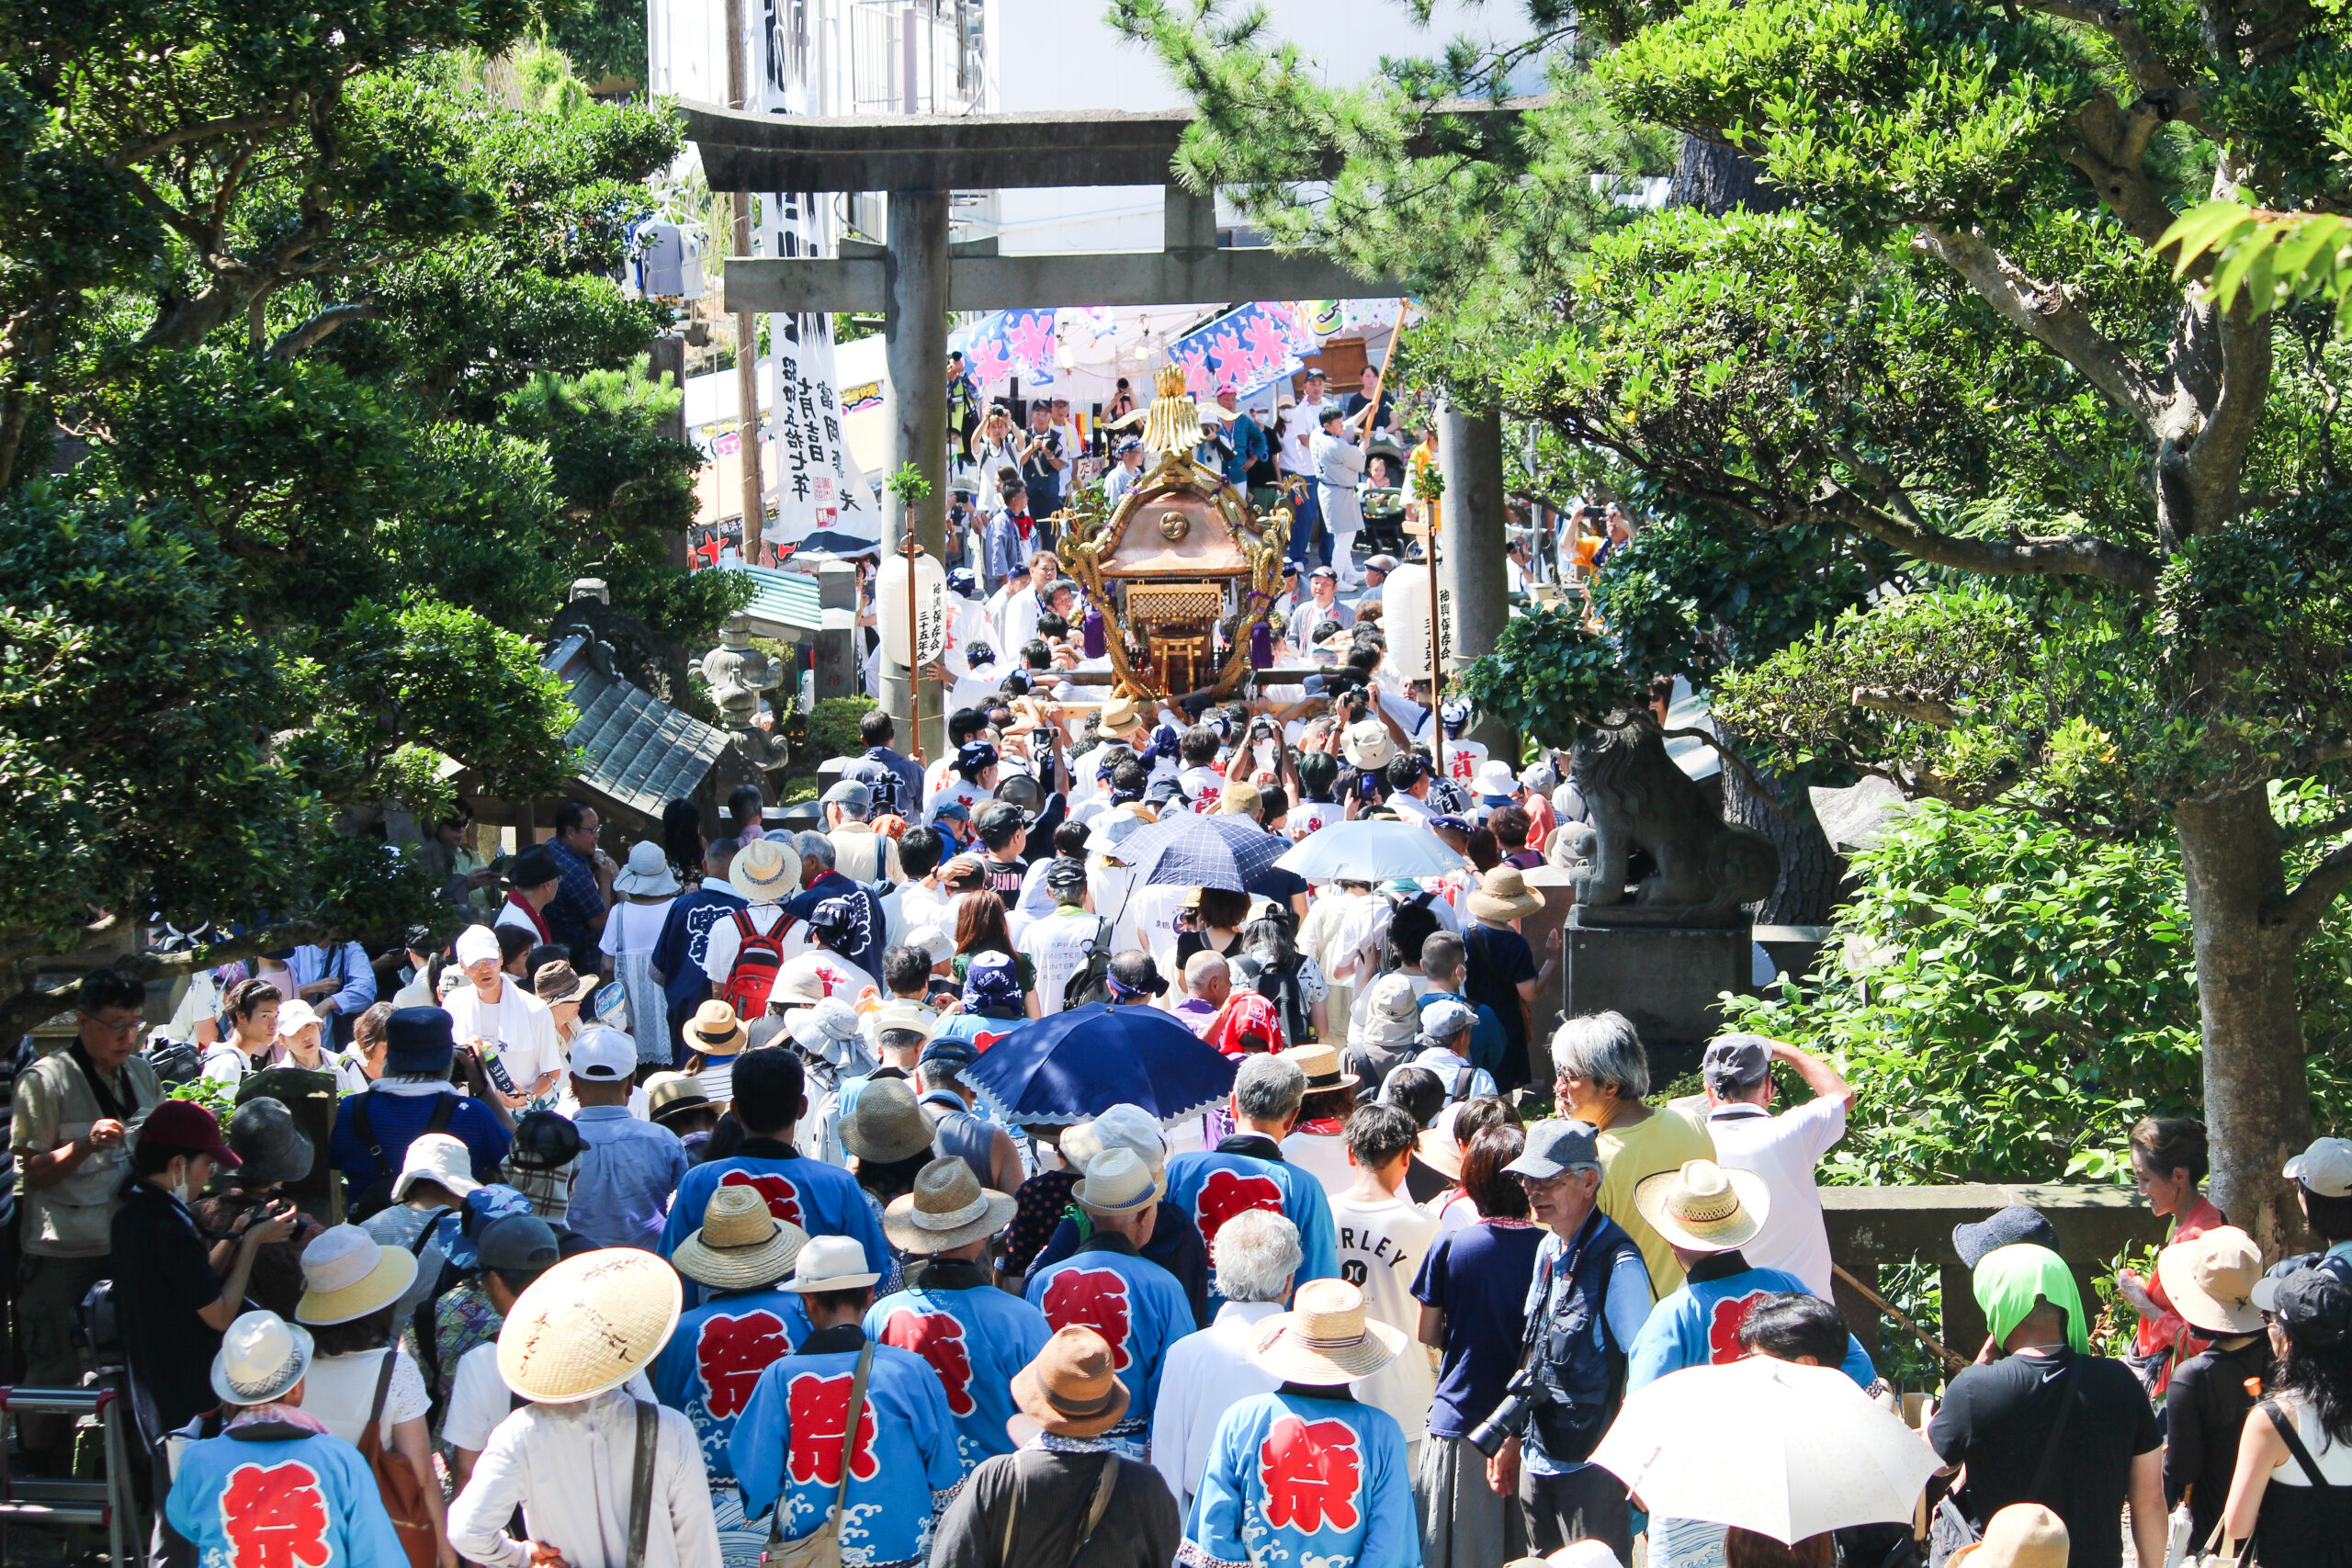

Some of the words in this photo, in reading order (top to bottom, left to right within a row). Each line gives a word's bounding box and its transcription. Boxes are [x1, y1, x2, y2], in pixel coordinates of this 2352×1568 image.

[917, 611, 930, 660] 三十五年会
[1439, 589, 1451, 660] 神輿保存会
[1335, 1227, 1408, 1269] RLEY
[1261, 1416, 1364, 1533] 祭
